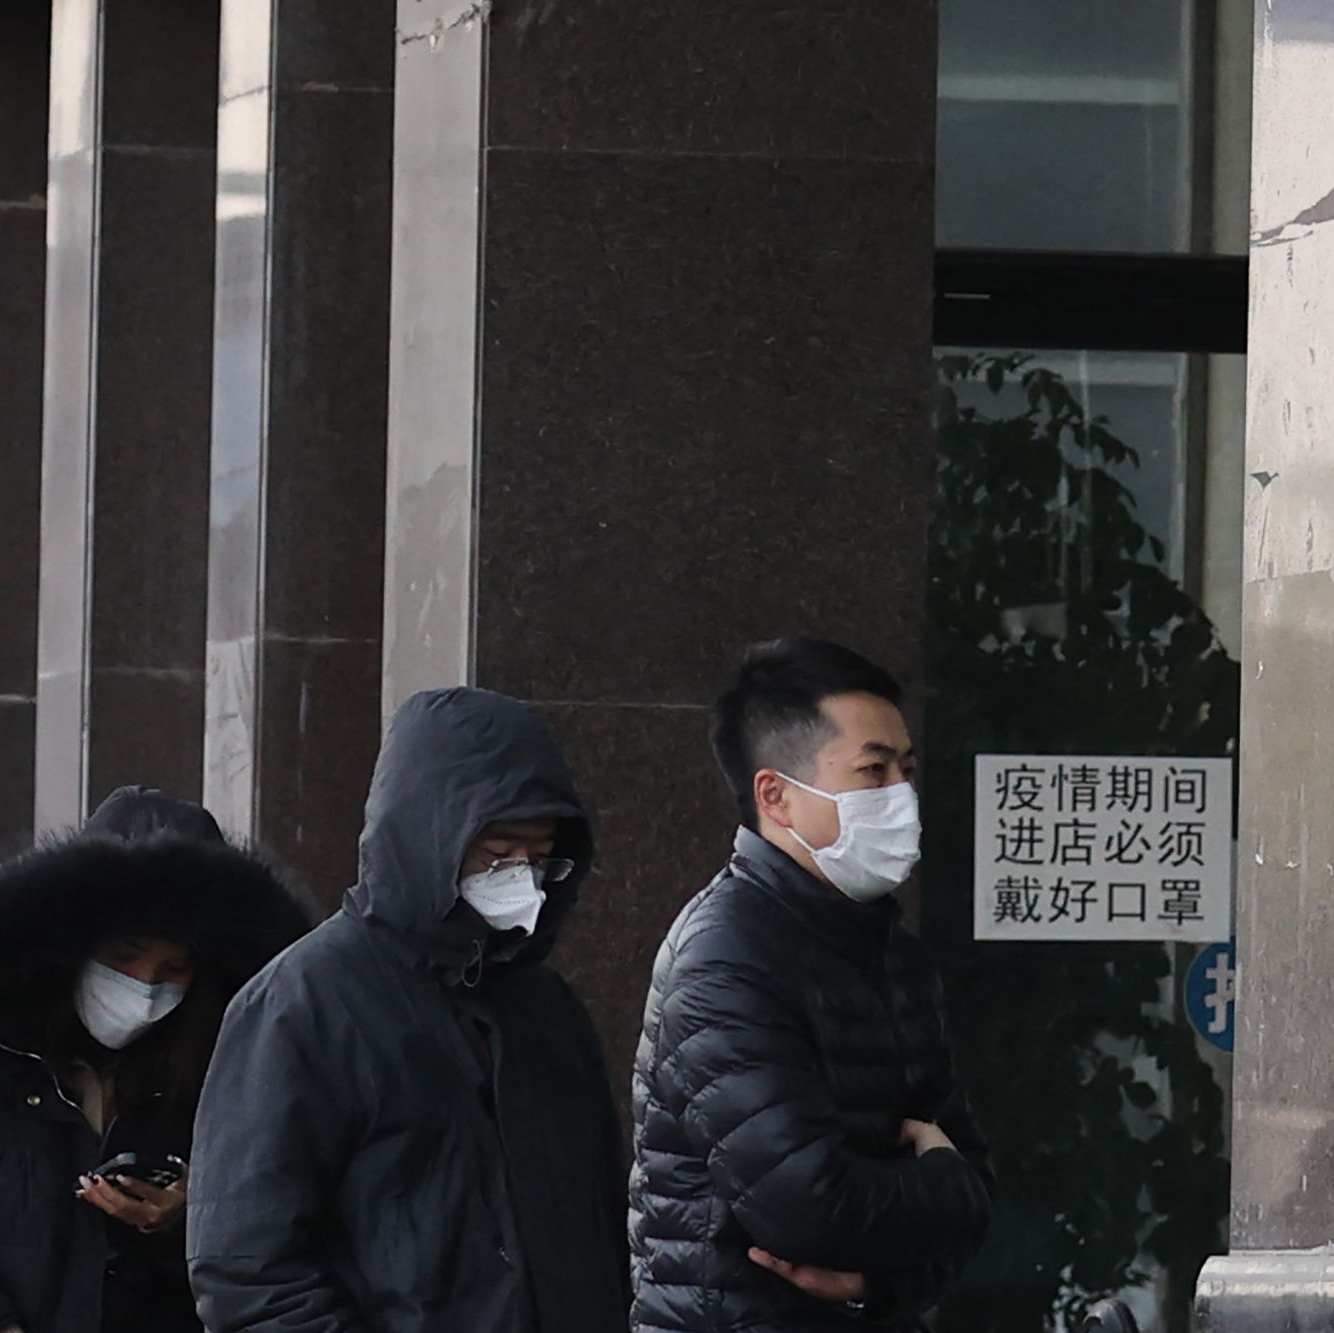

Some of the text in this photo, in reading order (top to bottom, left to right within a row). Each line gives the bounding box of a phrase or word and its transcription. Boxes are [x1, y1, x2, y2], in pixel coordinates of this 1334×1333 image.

[994, 763, 1207, 814] 疫情期间
[994, 816, 1206, 867] 进店必须
[992, 875, 1205, 926] 戴好口罩
